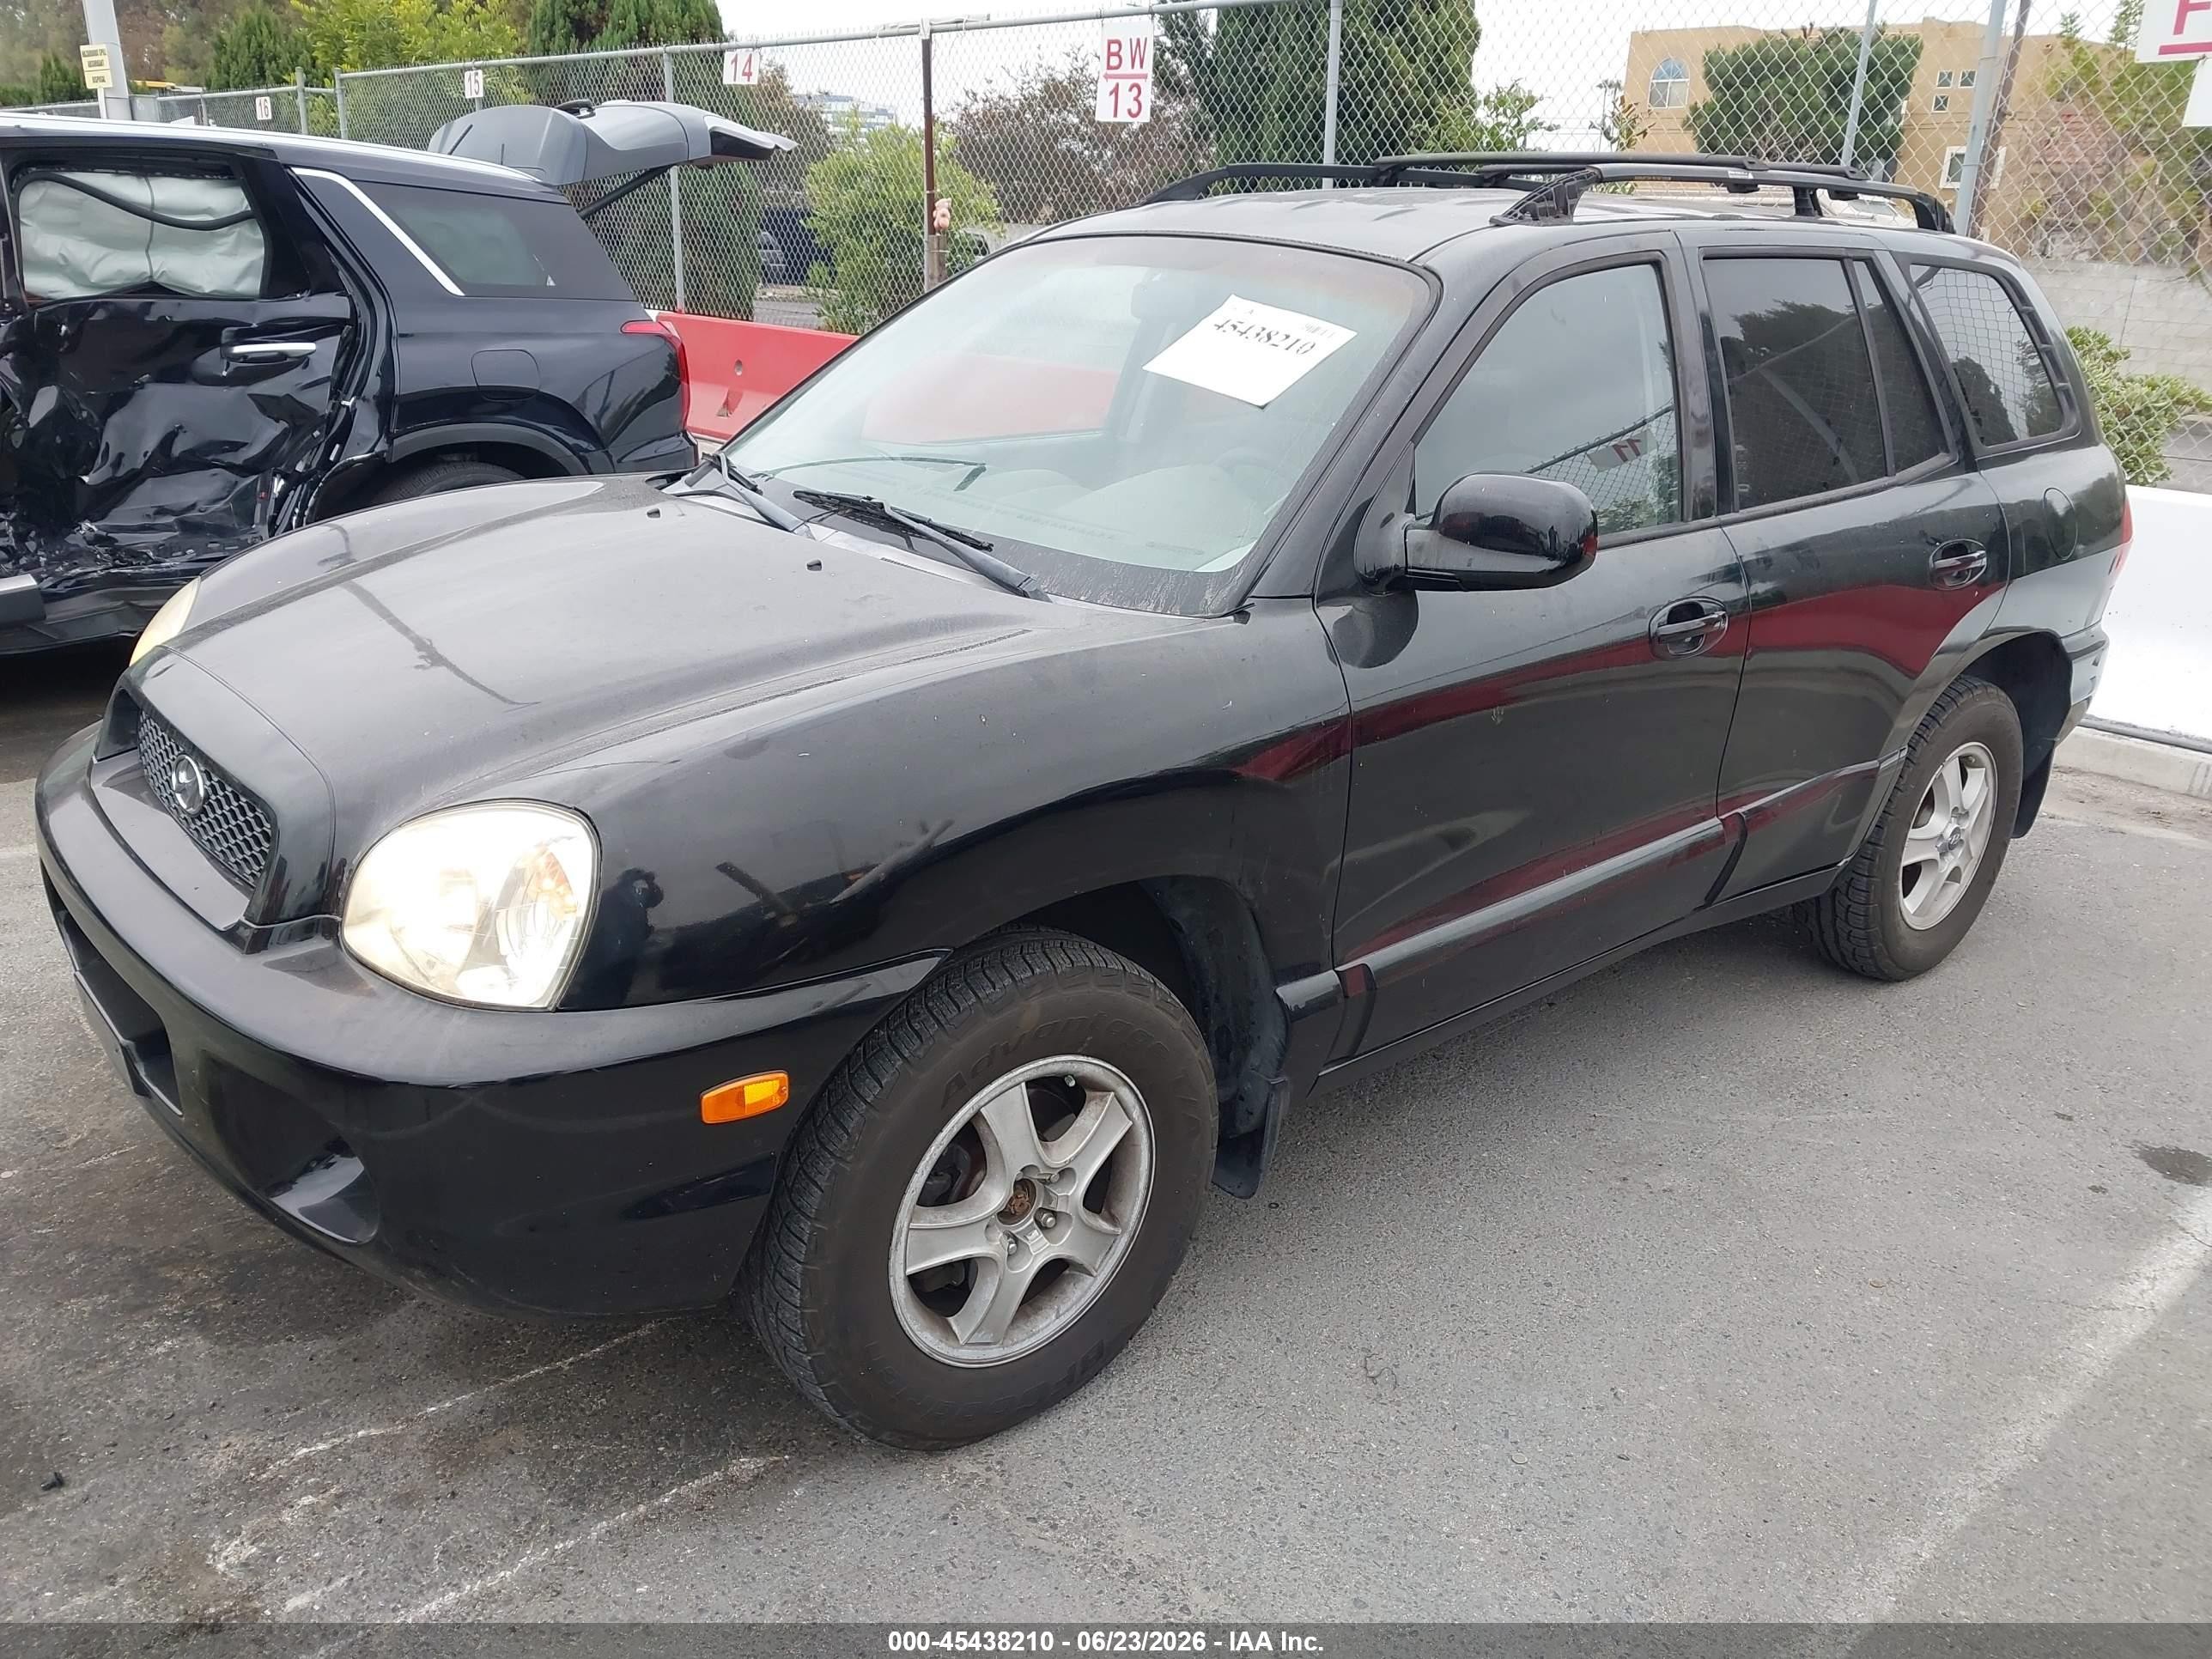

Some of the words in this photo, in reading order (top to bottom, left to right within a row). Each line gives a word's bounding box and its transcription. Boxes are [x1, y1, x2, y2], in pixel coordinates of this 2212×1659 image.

[730, 52, 753, 82] 14
[467, 71, 480, 97] 15
[258, 98, 270, 118] 16
[1109, 82, 1142, 118] 13
[1213, 319, 1316, 356] 45438210
